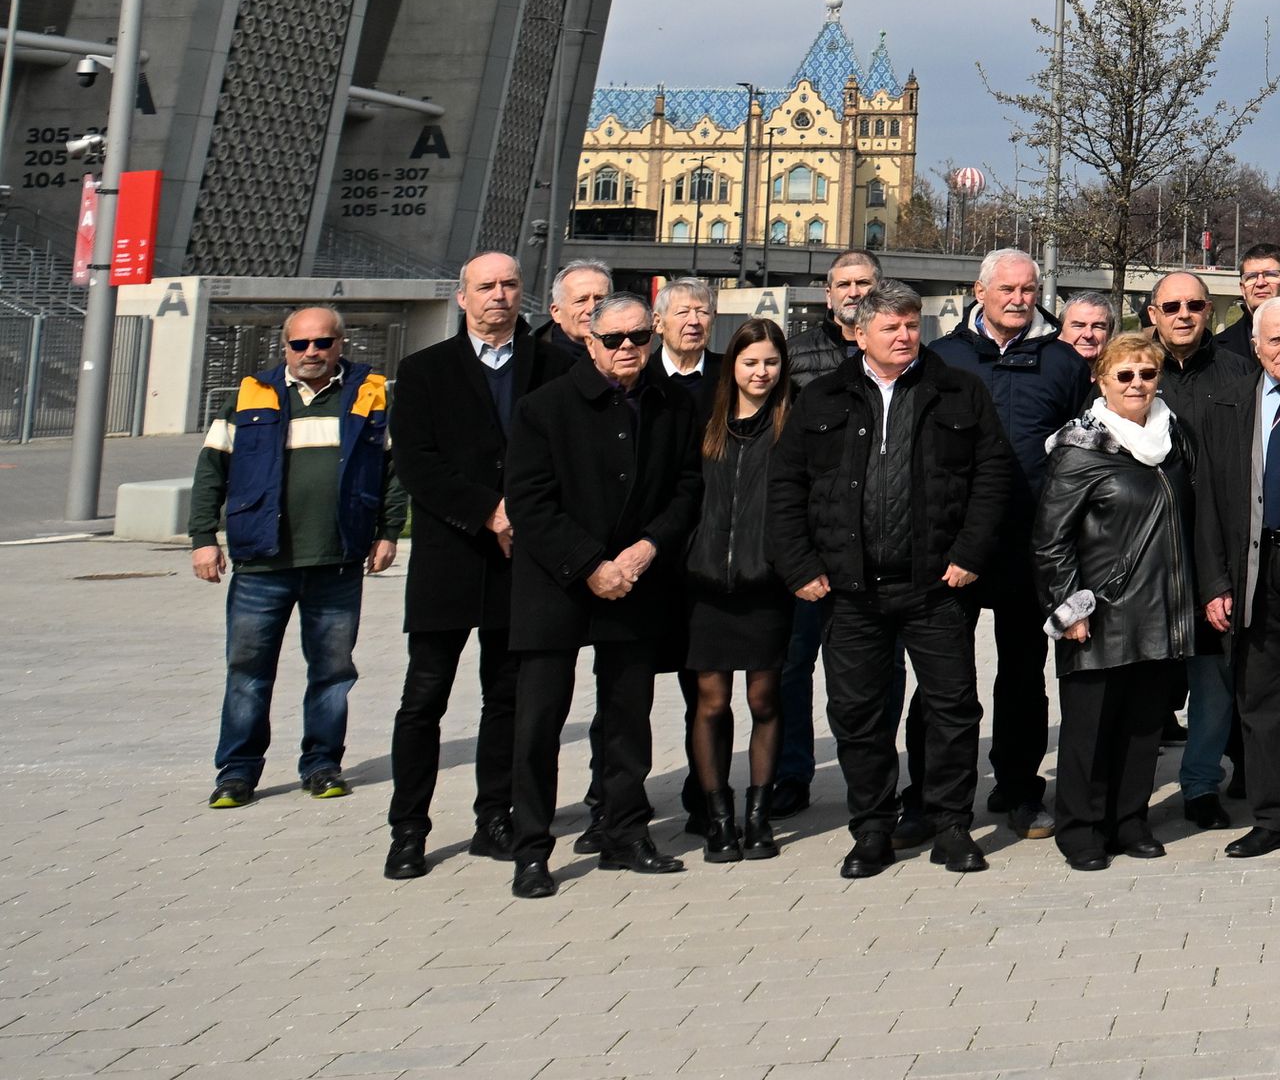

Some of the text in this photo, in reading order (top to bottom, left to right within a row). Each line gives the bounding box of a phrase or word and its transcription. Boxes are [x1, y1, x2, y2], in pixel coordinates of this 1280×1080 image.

[410, 125, 451, 159] A
[156, 282, 189, 317] A
[333, 280, 344, 296] A
[755, 291, 780, 315] A
[939, 298, 960, 317] A
